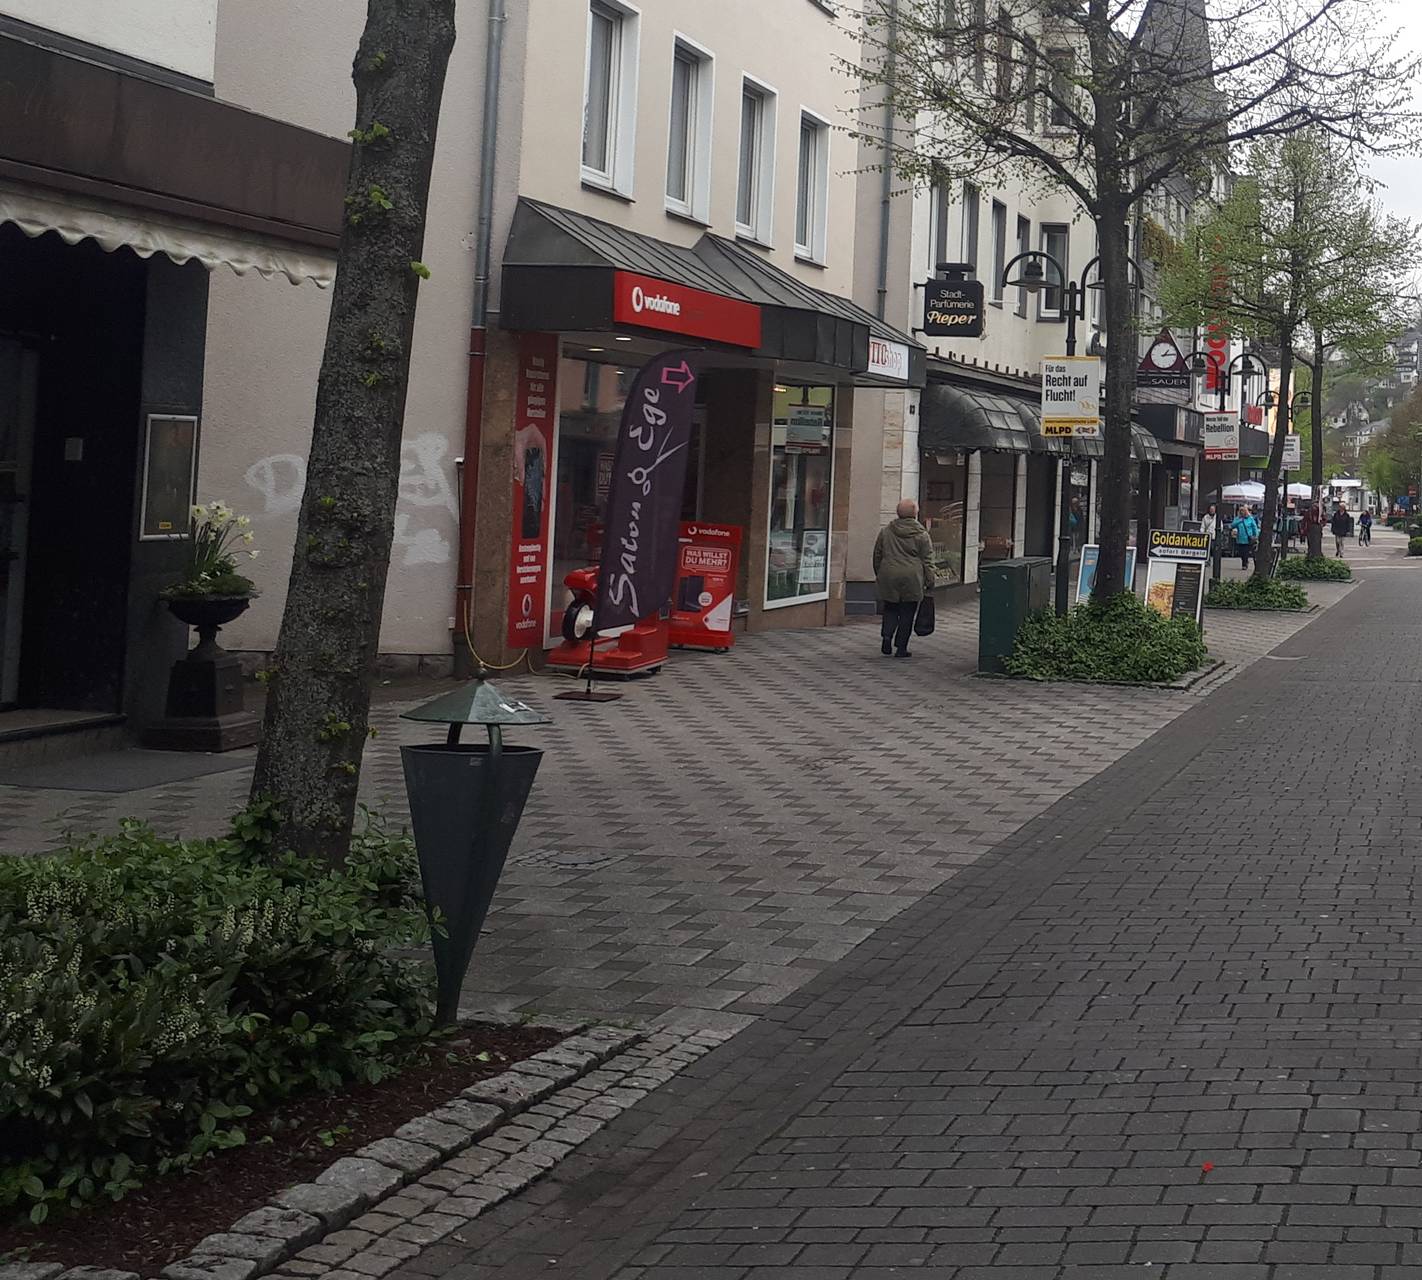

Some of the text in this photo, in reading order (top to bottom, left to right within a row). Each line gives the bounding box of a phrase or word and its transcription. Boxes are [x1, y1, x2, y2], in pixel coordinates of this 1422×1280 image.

[939, 289, 966, 299] Stadt-
[644, 294, 681, 316] vodafone
[930, 299, 975, 309] Parfümerie
[926, 311, 977, 327] Pieper
[1045, 364, 1066, 373] Für das
[1045, 374, 1088, 387] Recht auf
[1151, 378, 1187, 386] SAUER
[1045, 389, 1076, 402] Flucht!
[1045, 426, 1072, 435] MLPD
[1205, 423, 1235, 433] Rebellion
[698, 528, 730, 537] vodafone
[1152, 531, 1209, 548] Goldankauf
[703, 551, 728, 559] WILLST
[685, 556, 728, 567] DU MEHR?
